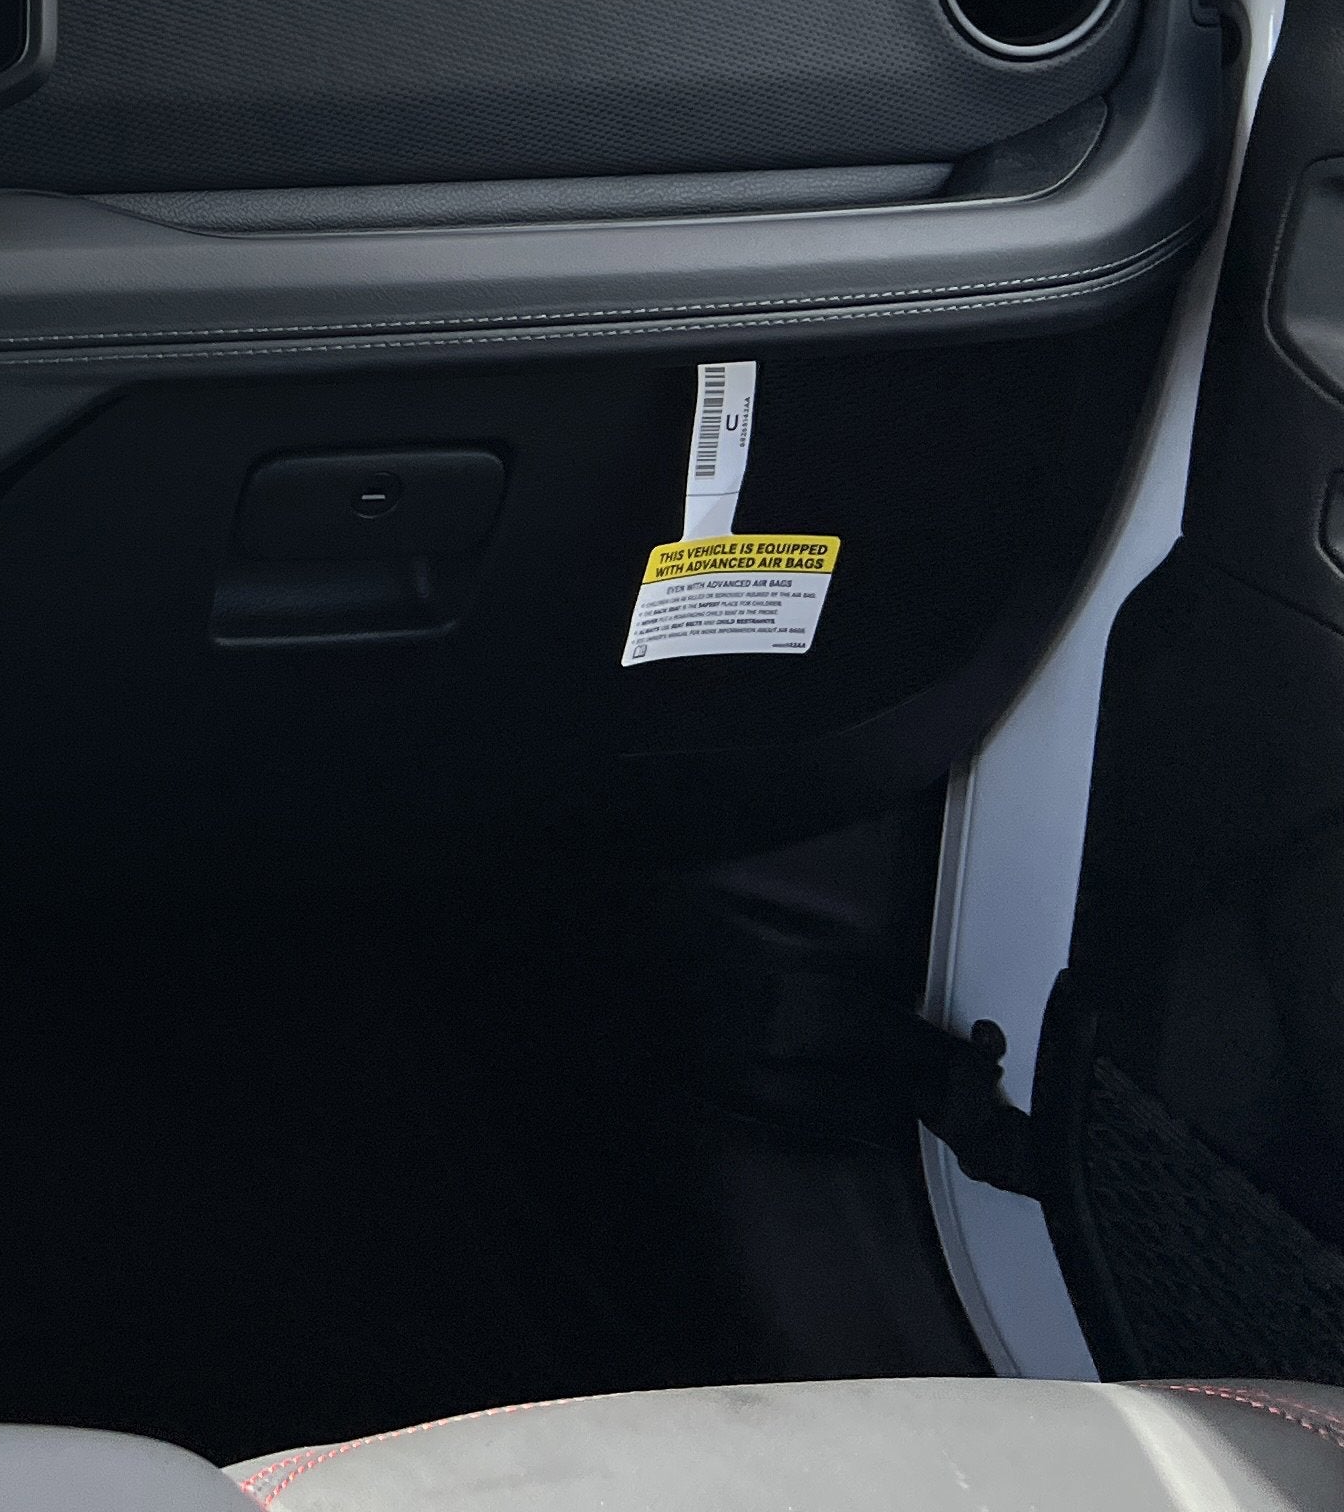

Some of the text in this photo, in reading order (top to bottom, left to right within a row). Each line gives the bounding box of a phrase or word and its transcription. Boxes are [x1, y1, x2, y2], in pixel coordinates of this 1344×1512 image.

[660, 543, 829, 564] THIS VEHICLE IS EQUIPPED
[655, 557, 824, 578] WITH ADVANCED AIR BAGS
[706, 580, 751, 589] ADVANCED
[769, 579, 793, 588] BAGS
